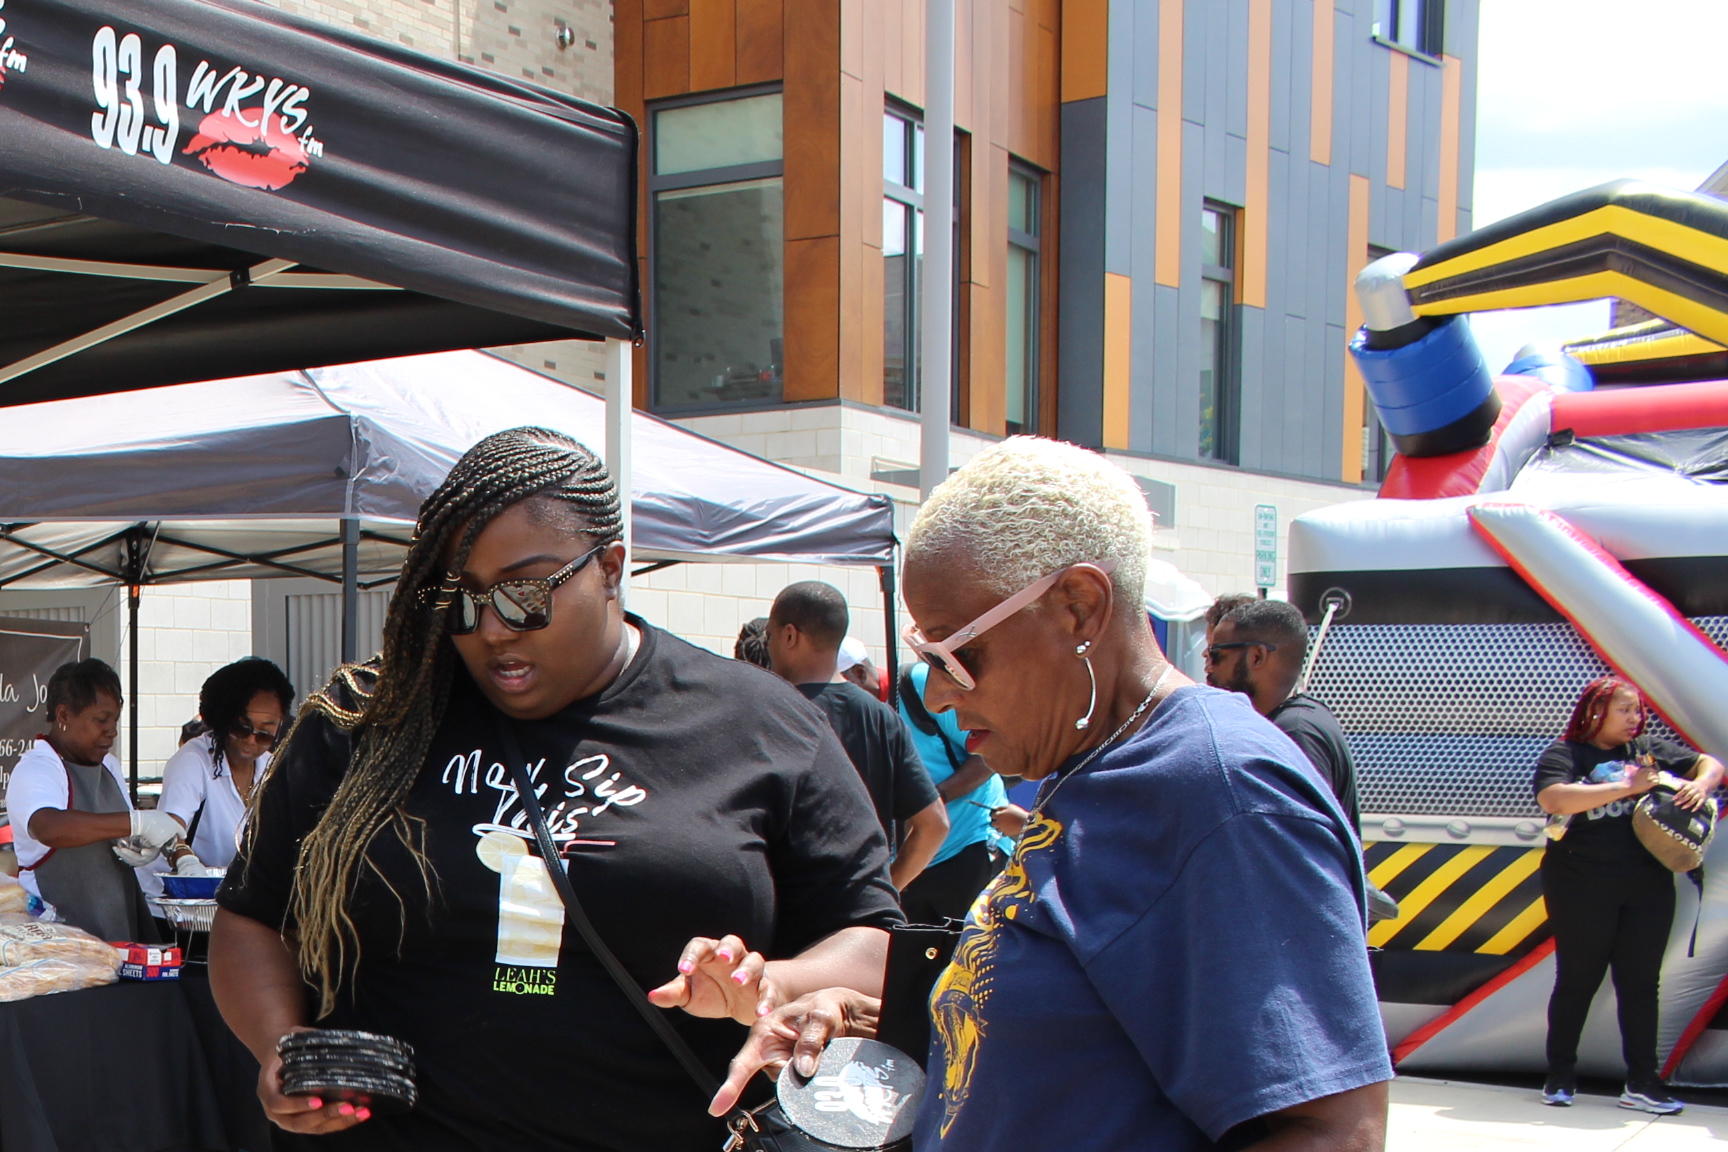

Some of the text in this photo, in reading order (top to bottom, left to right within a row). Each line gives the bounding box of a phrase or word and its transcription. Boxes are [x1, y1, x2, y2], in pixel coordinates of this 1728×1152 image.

[91, 26, 324, 165] 93.9 WKYS fm
[26, 672, 49, 715] Jo
[564, 754, 647, 817] Sip
[123, 969, 143, 978] SHEETS
[493, 981, 555, 996] LEMONADE
[494, 967, 557, 984] LEAH'S
